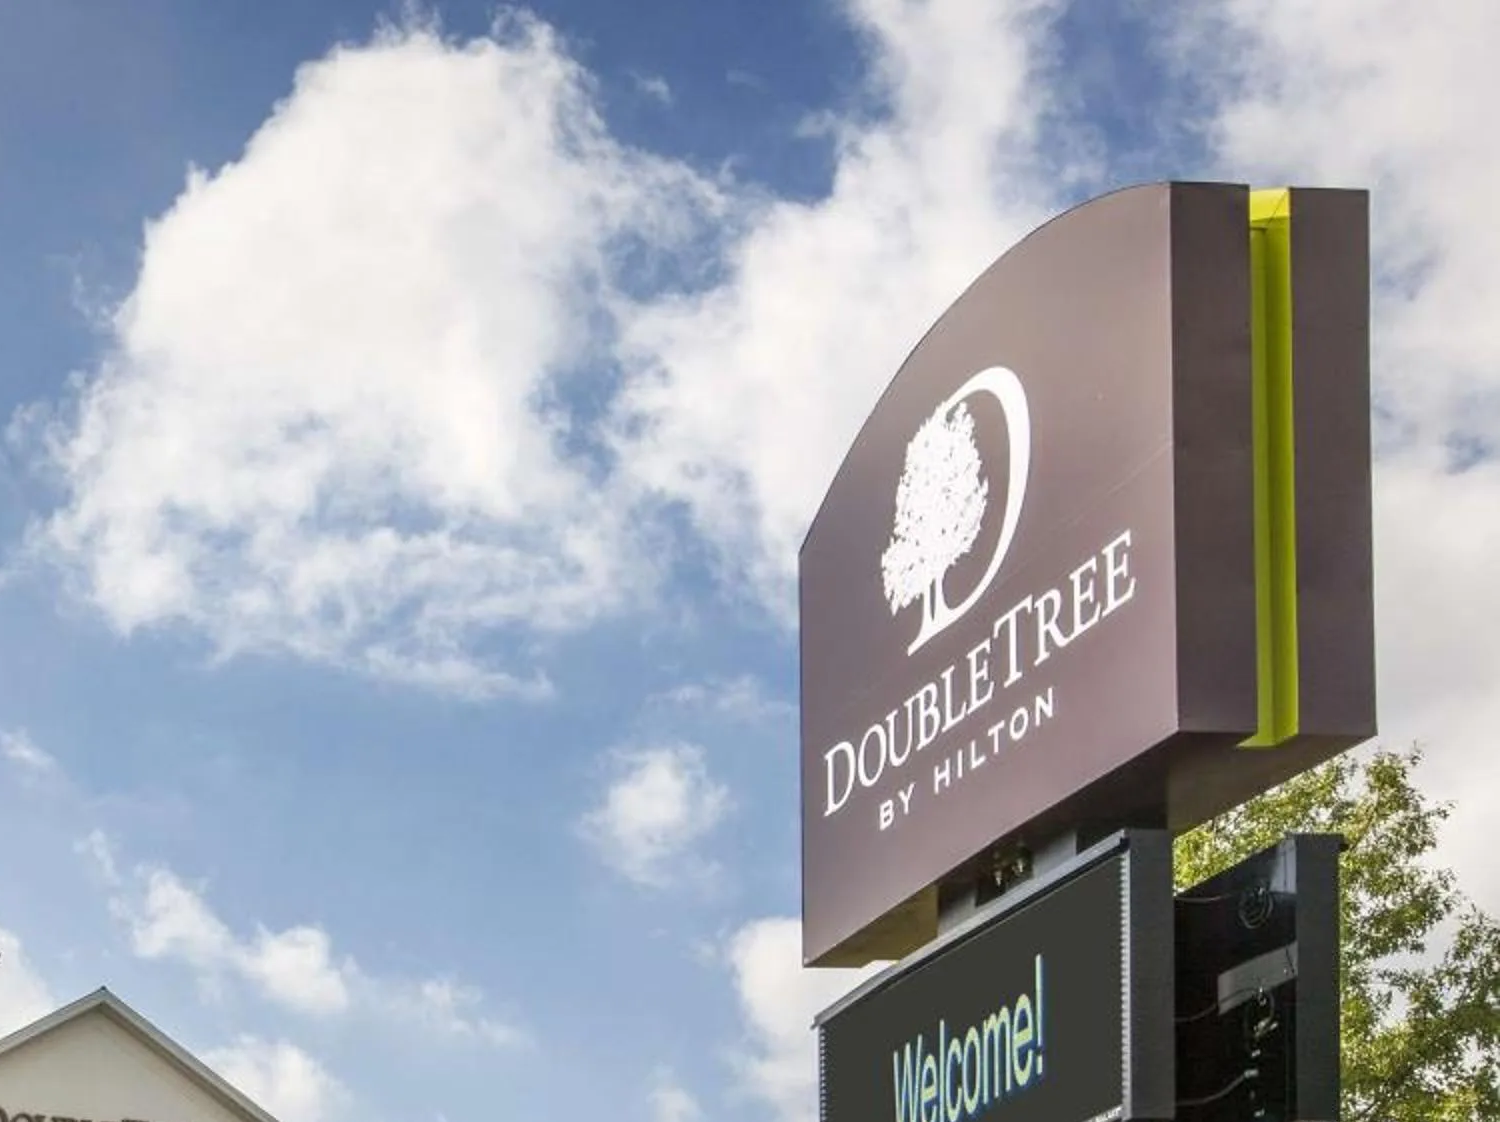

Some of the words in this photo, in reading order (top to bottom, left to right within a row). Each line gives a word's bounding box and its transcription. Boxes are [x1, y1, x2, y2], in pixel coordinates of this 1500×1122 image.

[823, 529, 1137, 817] DOUBLETREE
[879, 784, 915, 830] BY
[933, 687, 1056, 794] HILTON
